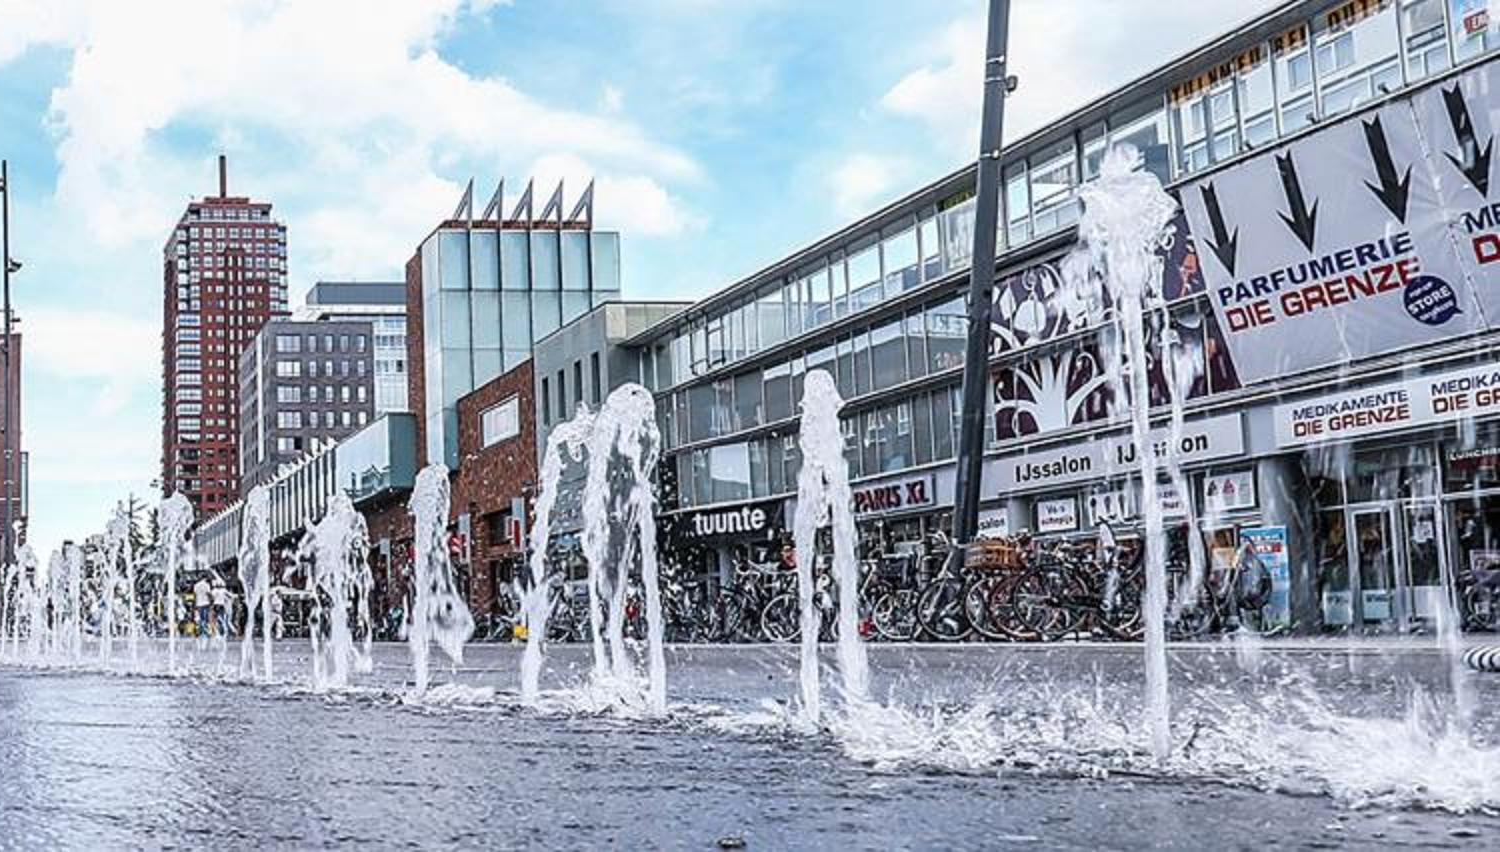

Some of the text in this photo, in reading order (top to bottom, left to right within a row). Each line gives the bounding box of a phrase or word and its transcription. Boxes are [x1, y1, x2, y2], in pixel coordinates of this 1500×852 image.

[1218, 231, 1415, 306] PARFUMERIE
[1225, 300, 1275, 332] DIE
[1279, 256, 1421, 317] GRENZE
[1408, 285, 1452, 314] STORE
[1292, 389, 1410, 421] MEDIKAMENTE
[1432, 393, 1469, 415] DIE
[1293, 403, 1411, 438] DIE GRENZE
[1015, 454, 1091, 483] IJssalon
[854, 479, 931, 513] PARIS XL
[693, 506, 766, 535] tuunte
